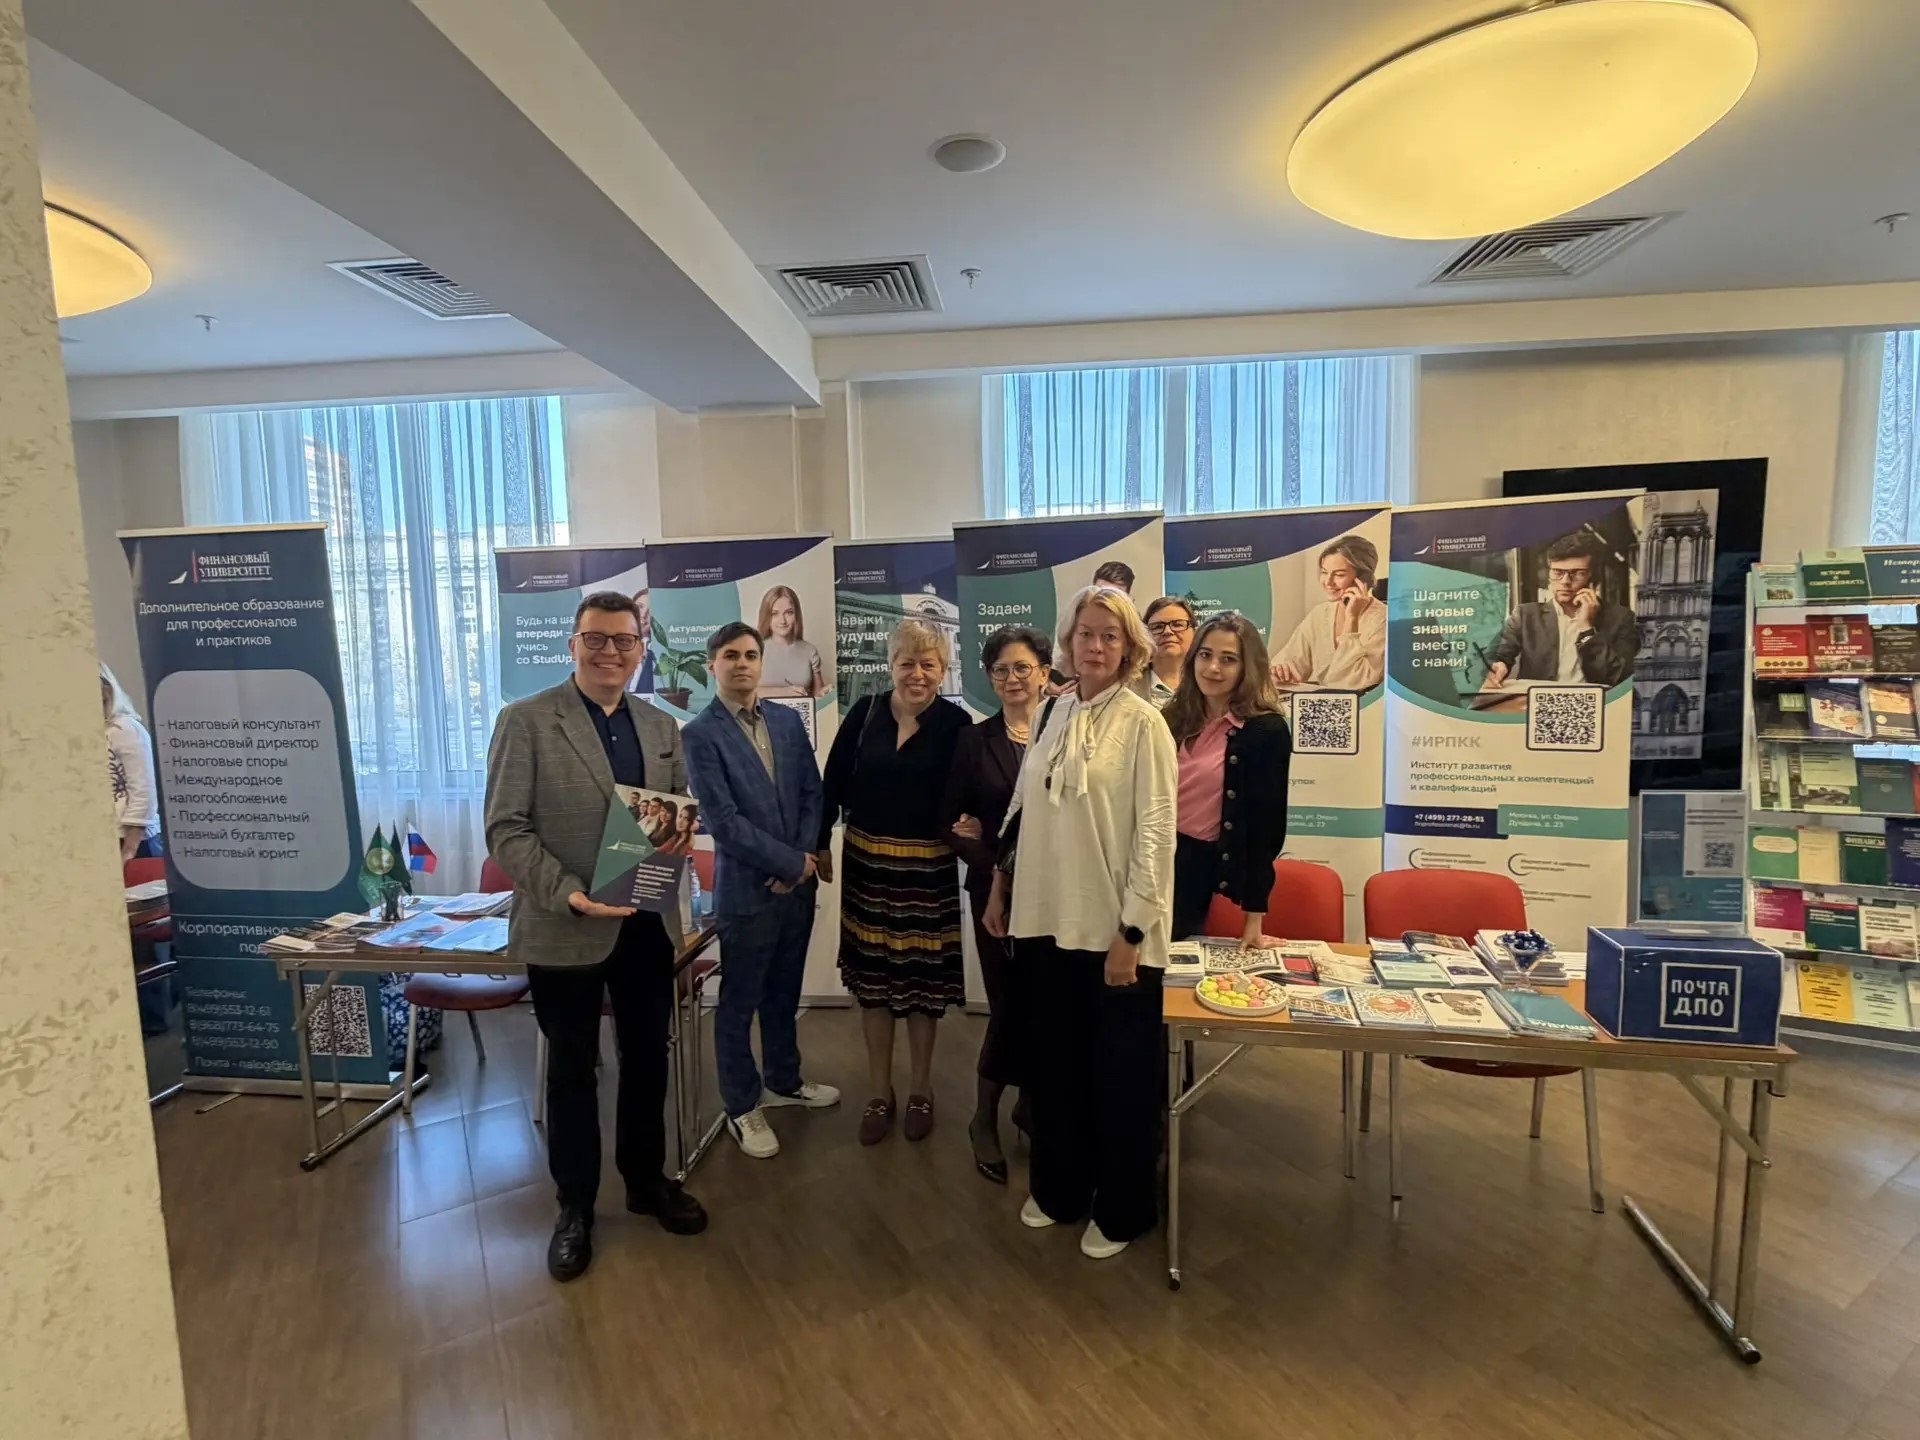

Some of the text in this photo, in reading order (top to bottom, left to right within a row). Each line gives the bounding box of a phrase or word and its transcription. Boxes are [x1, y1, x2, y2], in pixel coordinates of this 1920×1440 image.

[1437, 535, 1486, 544] ФИНАНСОВЫЙ
[198, 551, 271, 566] ФИНАНСОВЫЙ
[198, 566, 271, 577] УНИВЕРСИТЕТ
[1413, 590, 1481, 602] Шагните
[138, 598, 325, 615] Дополнительное образование
[977, 603, 1032, 617] Задаем
[1413, 607, 1475, 618] в новые
[166, 617, 298, 632] для профессионалов
[516, 616, 543, 628] Будь
[545, 617, 558, 625] на
[515, 630, 563, 641] впереди
[1412, 623, 1469, 635] знания
[195, 635, 272, 649] и практиков
[836, 631, 890, 644] будущег
[515, 644, 549, 655] учись
[837, 648, 860, 658] же
[1412, 641, 1467, 652] вместе
[516, 657, 530, 665] со
[1412, 655, 1468, 668] с нами!
[167, 719, 239, 731] Налоговый
[242, 720, 321, 732] консультант
[169, 737, 253, 750] Финансовый
[256, 738, 320, 751] директор
[1411, 735, 1481, 749] #ИРПКК
[172, 756, 243, 768] Налоговые
[246, 757, 288, 770] споры
[1410, 760, 1513, 772] Институт развития
[174, 774, 284, 788] Международное
[1410, 772, 1595, 786] профессиональных компетенций
[1410, 784, 1497, 794] и квалификаций
[168, 792, 289, 804] налогообложение
[178, 810, 310, 824] Профессиональный
[173, 829, 296, 843] главный бухгалтер
[183, 847, 256, 859] Налоговый
[258, 850, 301, 861] юрист
[178, 920, 289, 936] Корпоративное
[1671, 978, 1730, 996] ПОЧТА
[1672, 997, 1725, 1017] ДПО
